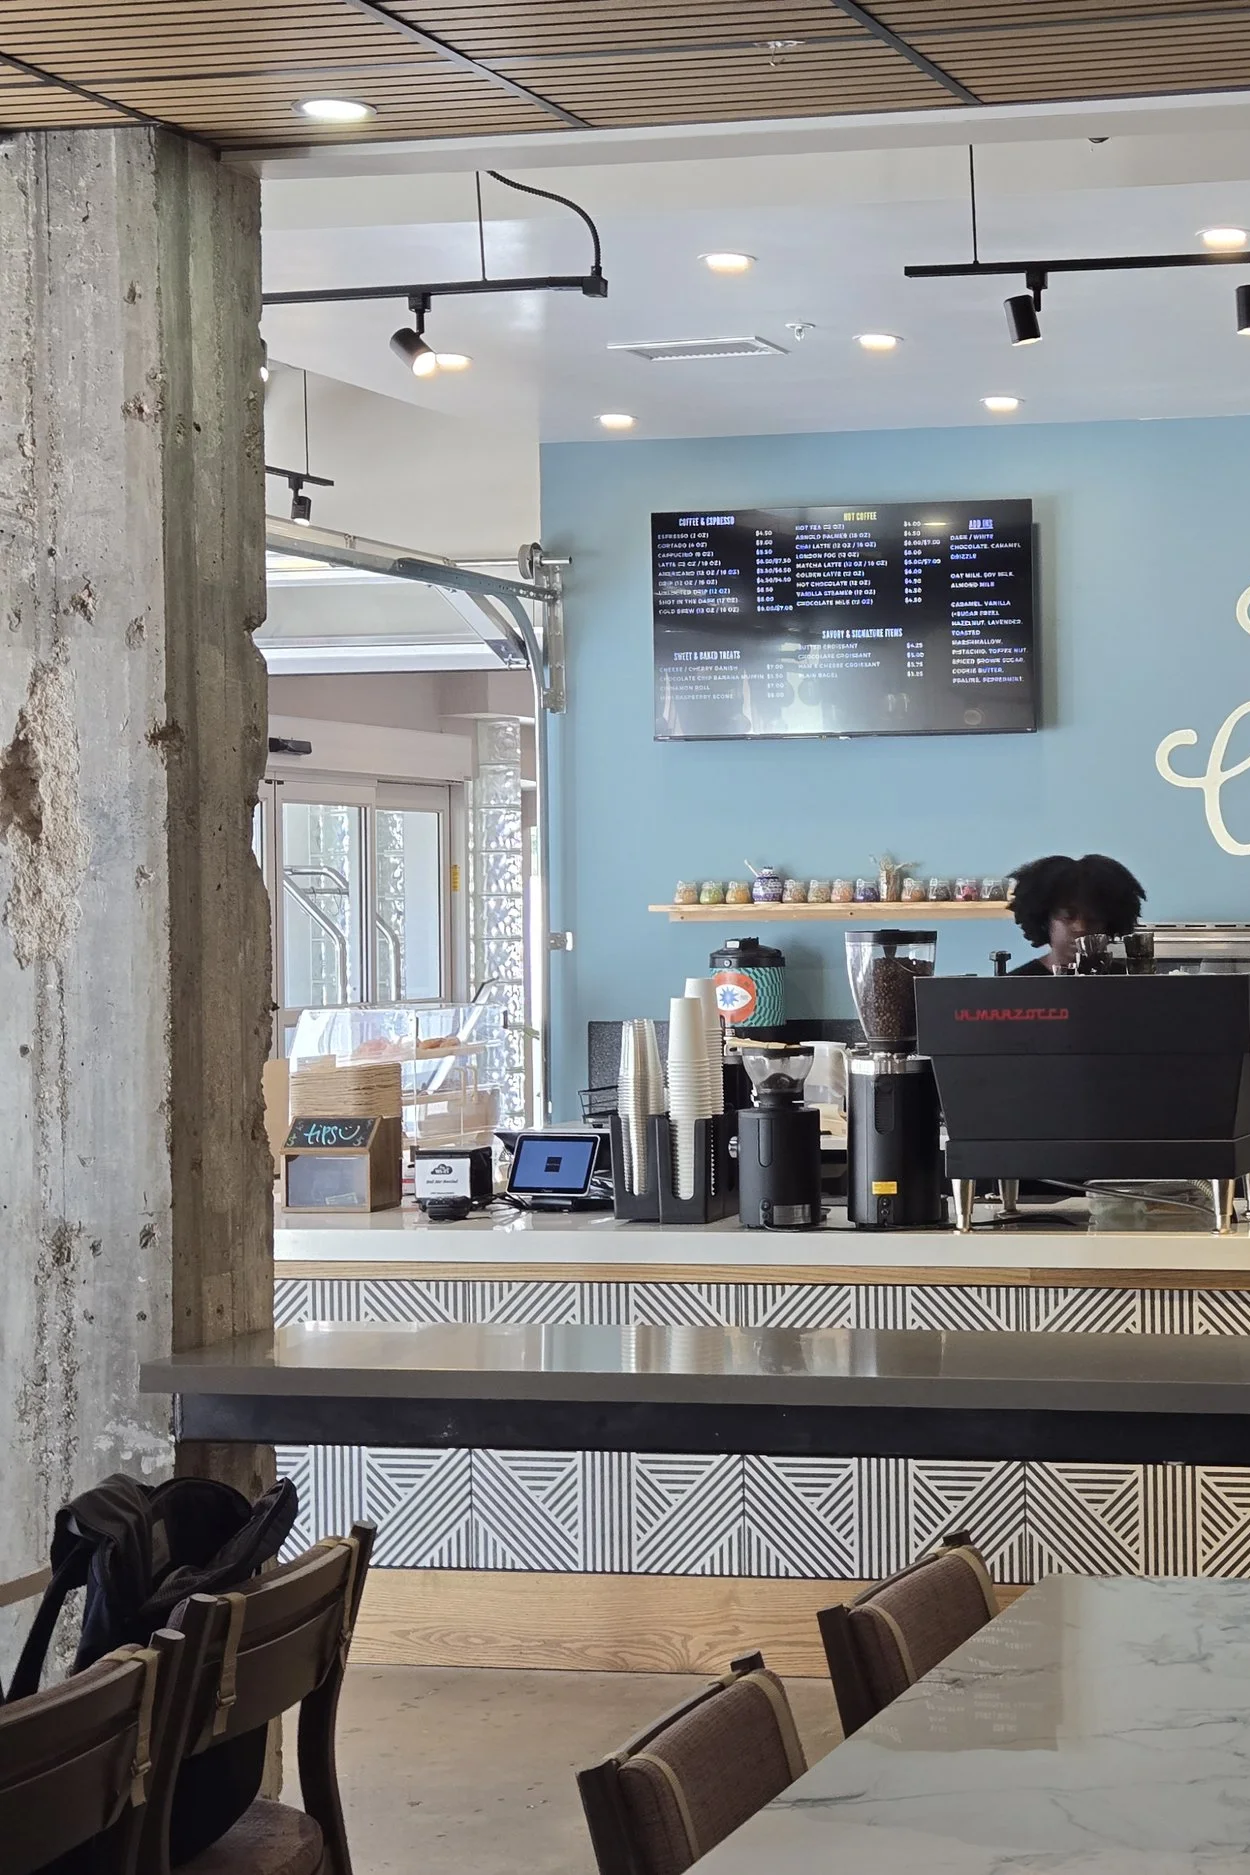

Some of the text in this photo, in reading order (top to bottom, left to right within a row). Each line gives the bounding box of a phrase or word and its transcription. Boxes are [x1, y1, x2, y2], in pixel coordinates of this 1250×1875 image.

[679, 516, 735, 526] COFFEE & ESPRESSO
[844, 512, 877, 521] HOT COFFEE
[822, 630, 844, 639] SAVORY
[852, 629, 883, 638] SIGNATURE
[885, 628, 902, 637] ITEMS
[674, 652, 692, 661] SWEET
[700, 651, 718, 660] BAKED
[720, 651, 740, 659] TREATS
